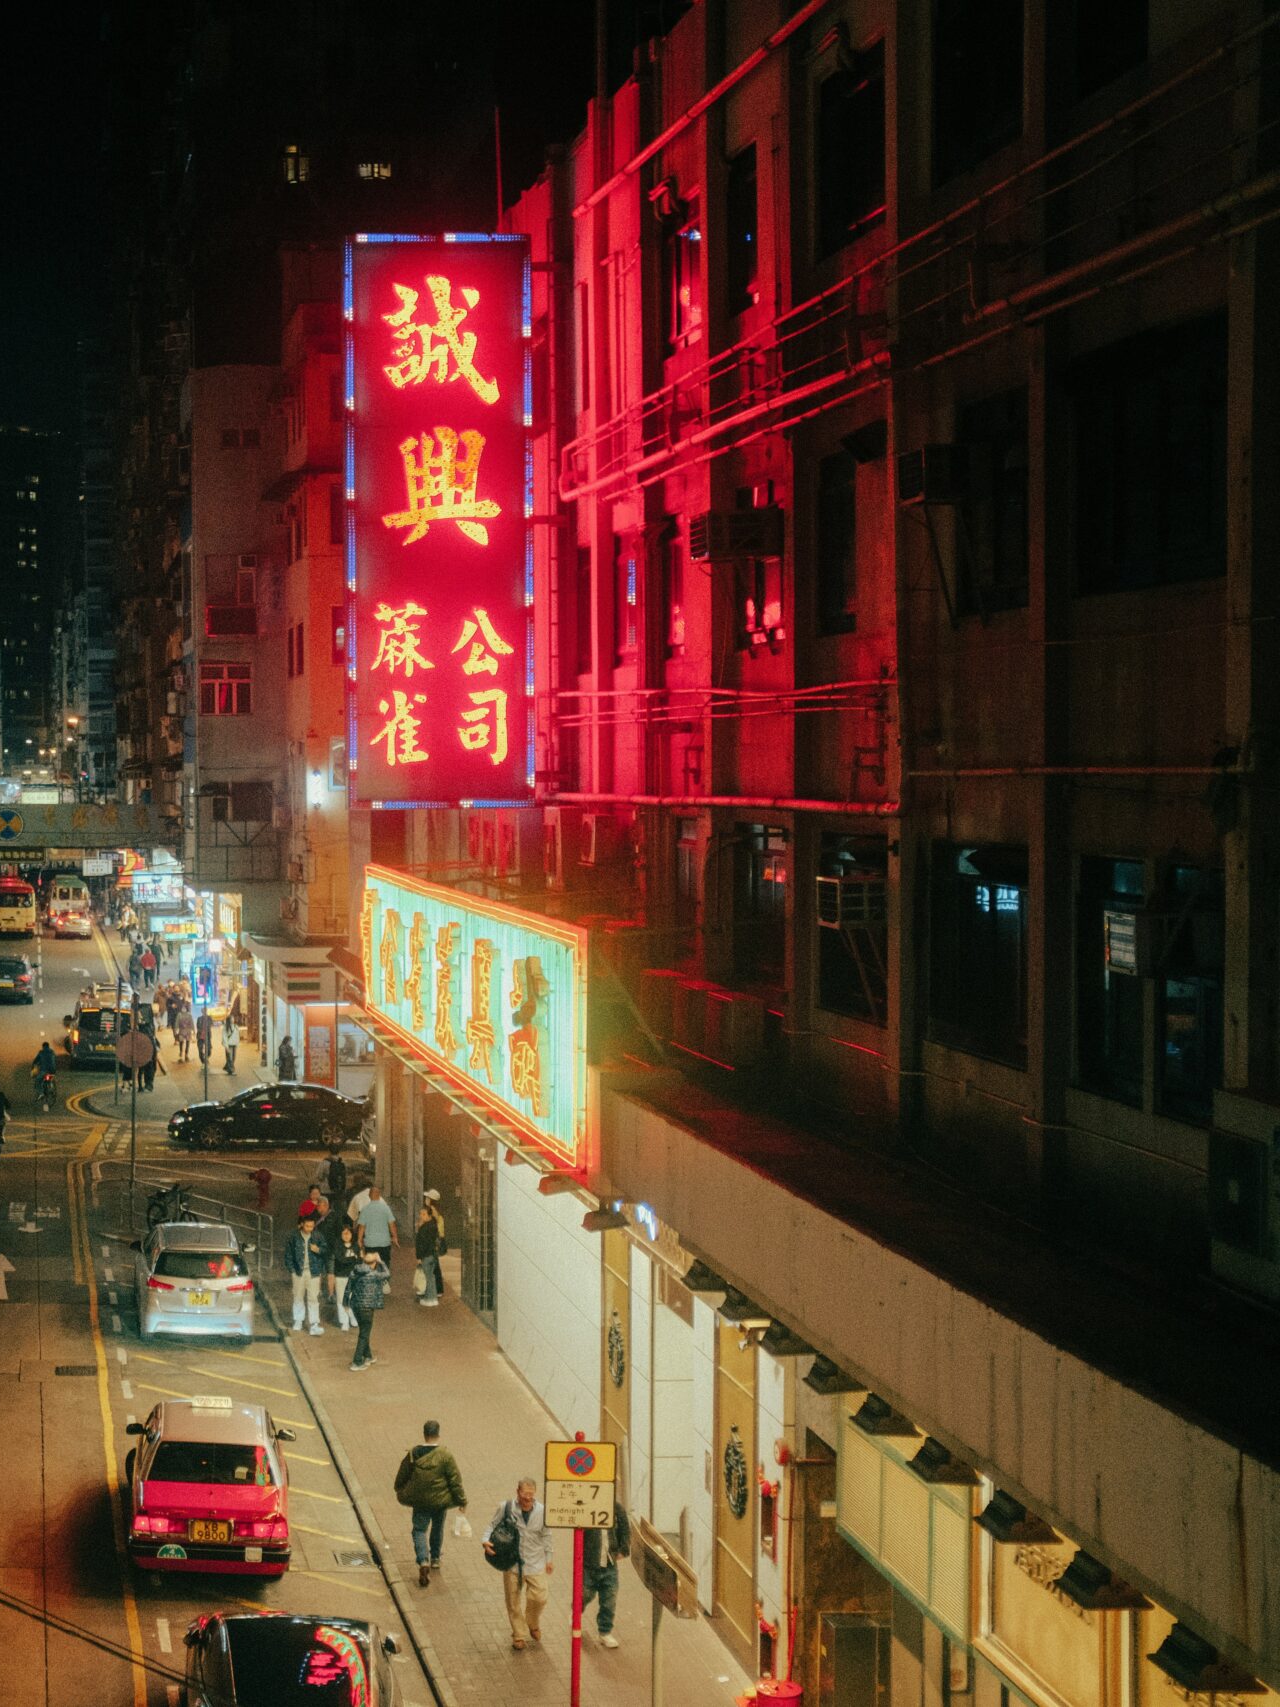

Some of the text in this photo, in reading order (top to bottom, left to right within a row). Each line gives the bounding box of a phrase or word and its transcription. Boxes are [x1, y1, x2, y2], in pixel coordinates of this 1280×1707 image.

[451, 608, 514, 766] 公司
[589, 1485, 600, 1500] 7
[590, 1510, 609, 1526] 12
